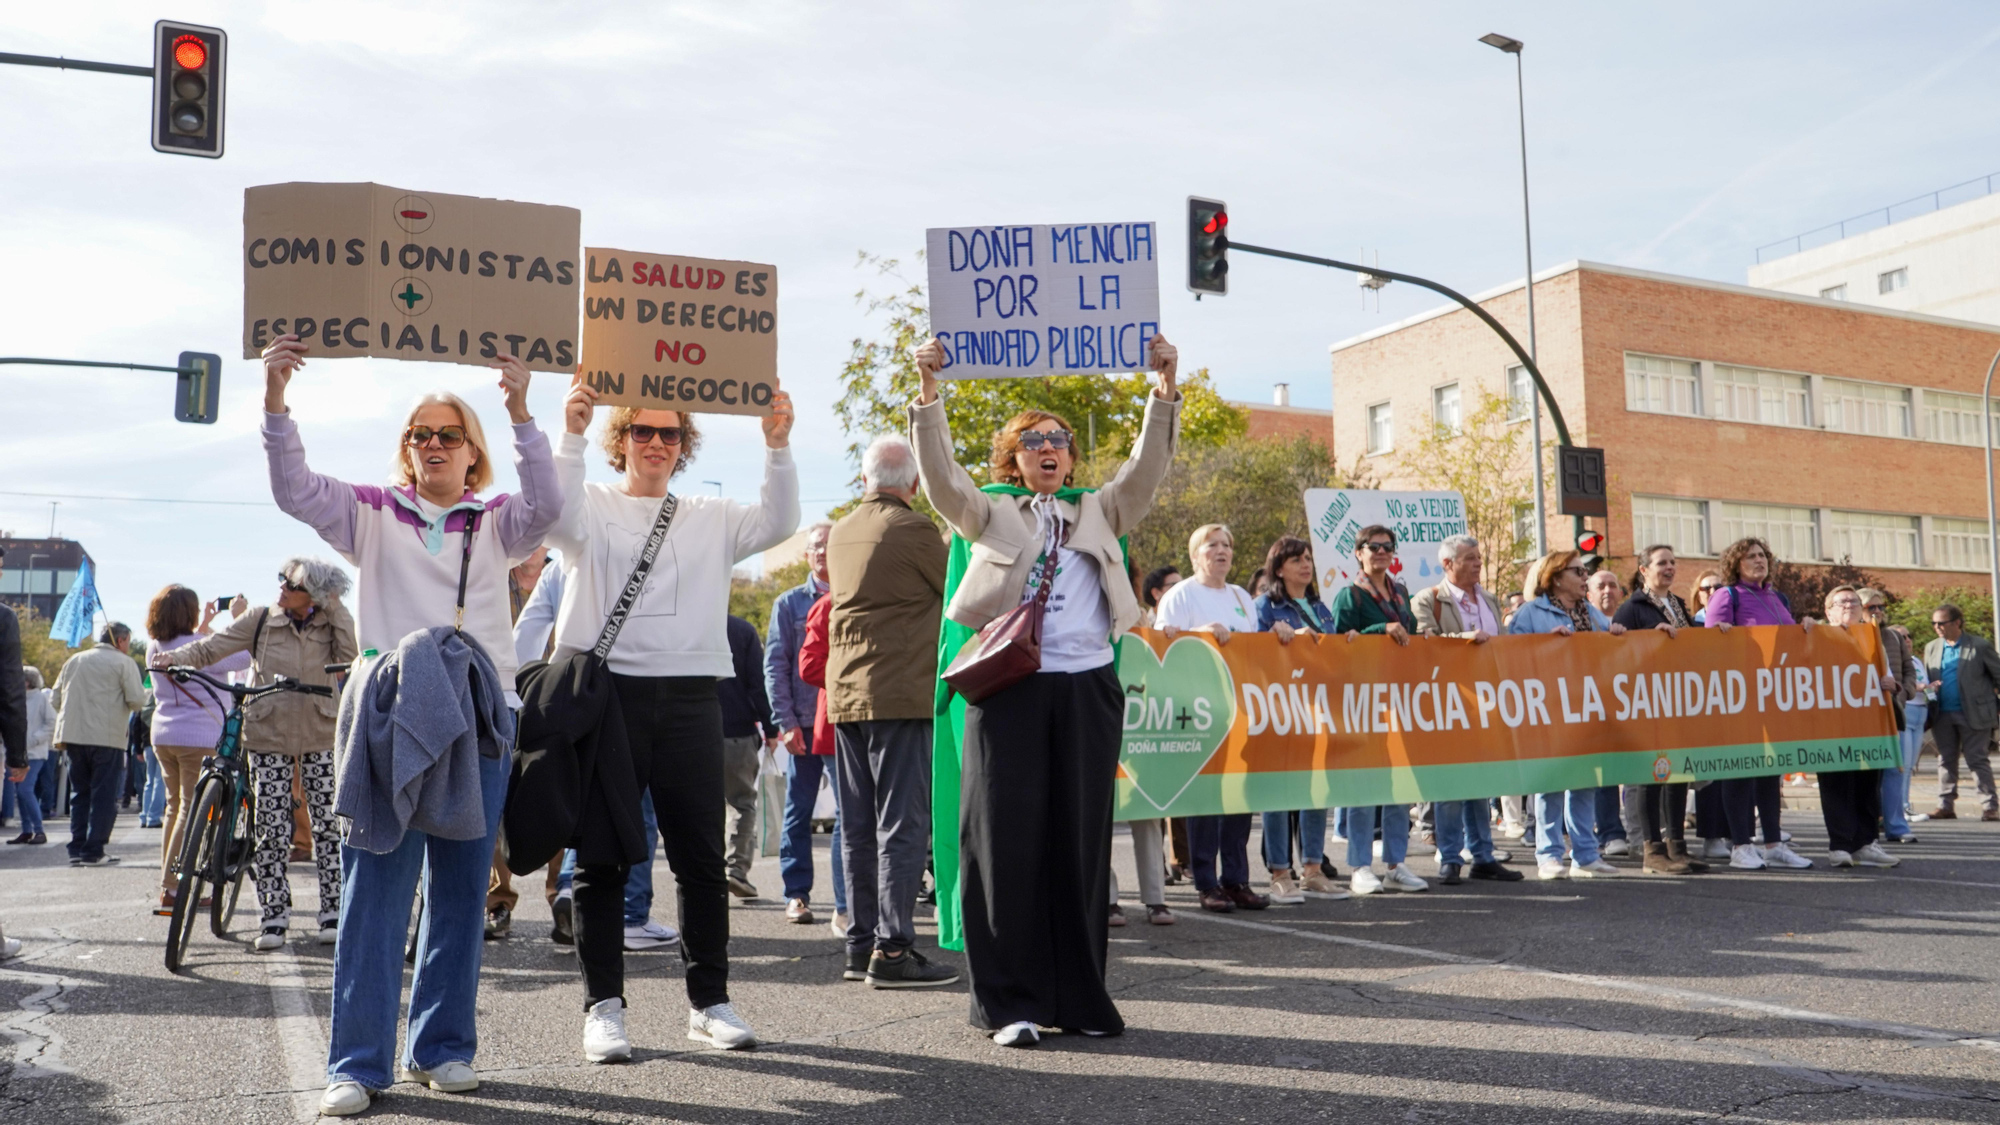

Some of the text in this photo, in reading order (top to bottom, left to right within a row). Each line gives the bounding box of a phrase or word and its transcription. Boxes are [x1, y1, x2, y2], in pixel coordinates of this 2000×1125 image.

[948, 223, 1152, 272] DOÑA MENCIA
[587, 255, 769, 297] LA SALUD ES
[586, 296, 775, 334] UN DERECHO
[973, 274, 1121, 319] POR LA
[252, 317, 574, 366] ESPECIALISTAS
[654, 338, 707, 365] NO
[935, 329, 1040, 369] SANIDAD
[587, 370, 773, 406] UN NEGOCIO
[1385, 498, 1460, 519] NO se VENDE
[623, 570, 646, 602] LOLA
[1241, 652, 1886, 736] DOÑA MENCÍA POR LA SANIDAD PÚBLICA
[1127, 738, 1202, 754] DOÑA MENCÍA
